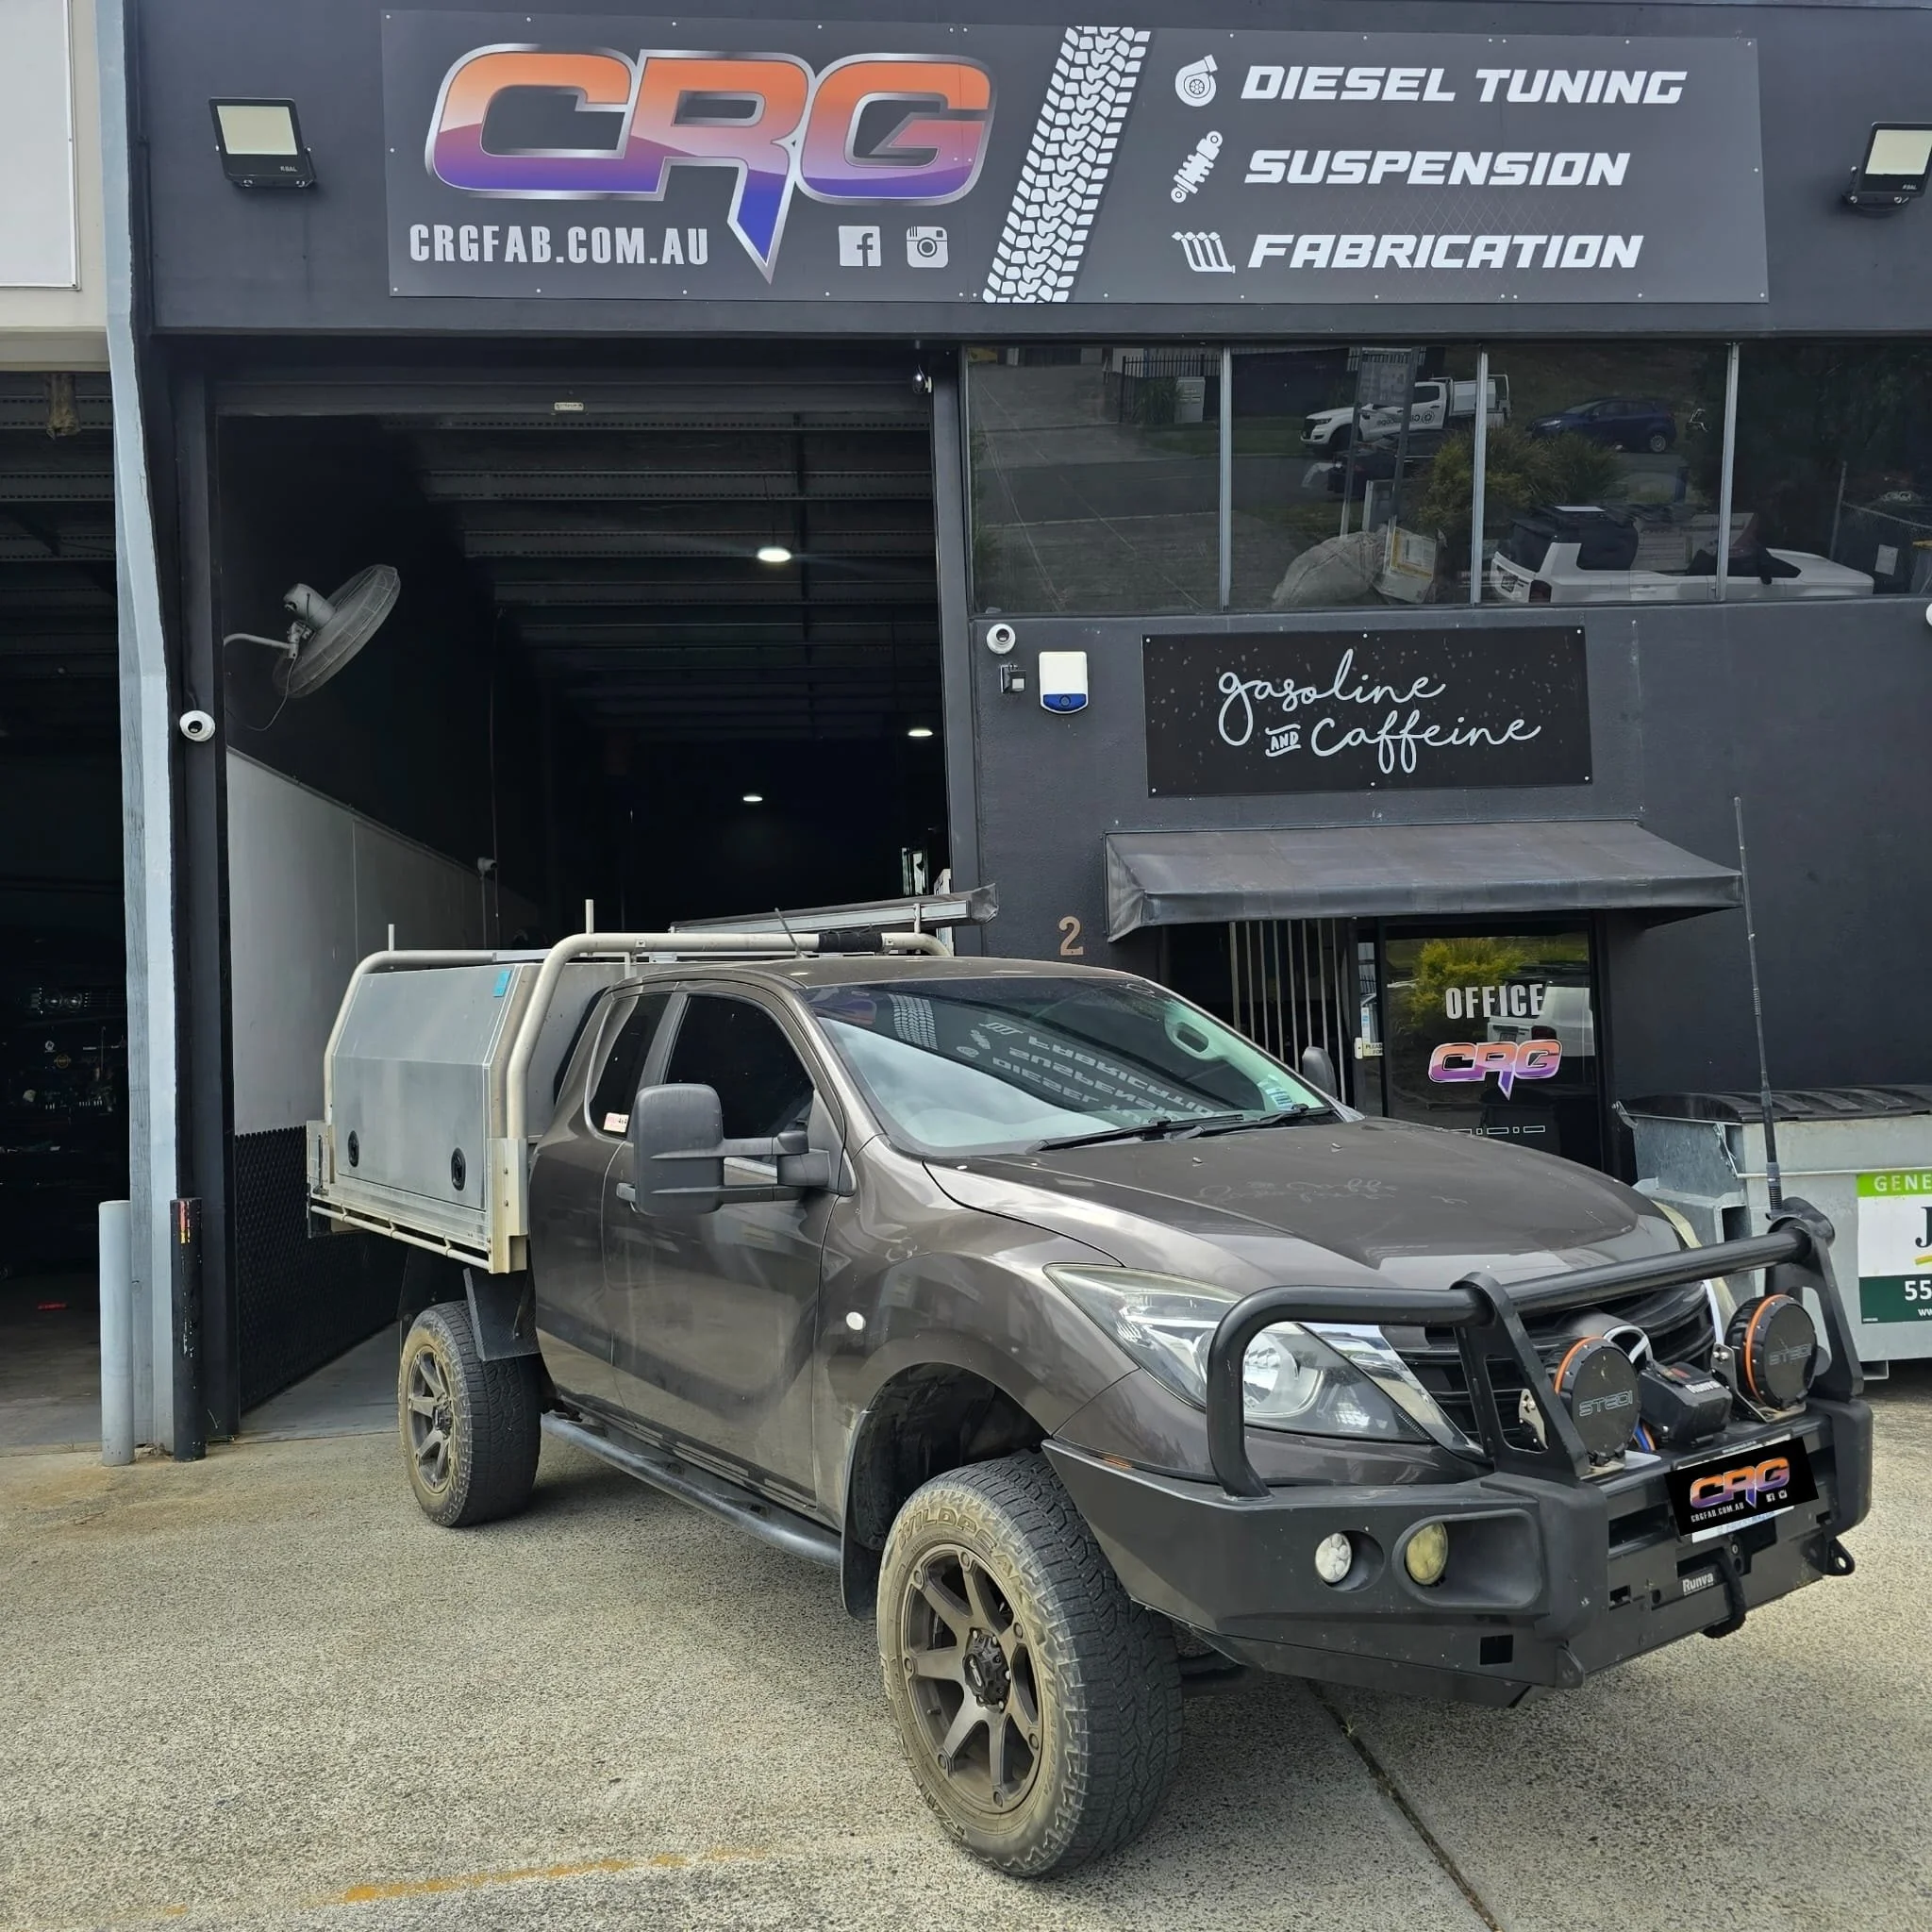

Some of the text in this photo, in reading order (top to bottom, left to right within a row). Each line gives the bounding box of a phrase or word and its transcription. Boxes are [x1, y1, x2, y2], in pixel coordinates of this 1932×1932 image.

[1241, 65, 1687, 105] DIESEL TUNING
[425, 42, 998, 284] CRG
[1243, 149, 1631, 186] SUSPENSION
[408, 223, 709, 266] CRGFAB.COM.AU
[1246, 233, 1644, 269] FABRICATION
[1218, 648, 1446, 745] gasoline
[1270, 733, 1300, 751] AND
[1058, 915, 1084, 957] 2
[1444, 983, 1544, 1020] OFFICE
[1427, 1039, 1563, 1101] CRG
[1682, 1573, 1714, 1592] Runva
